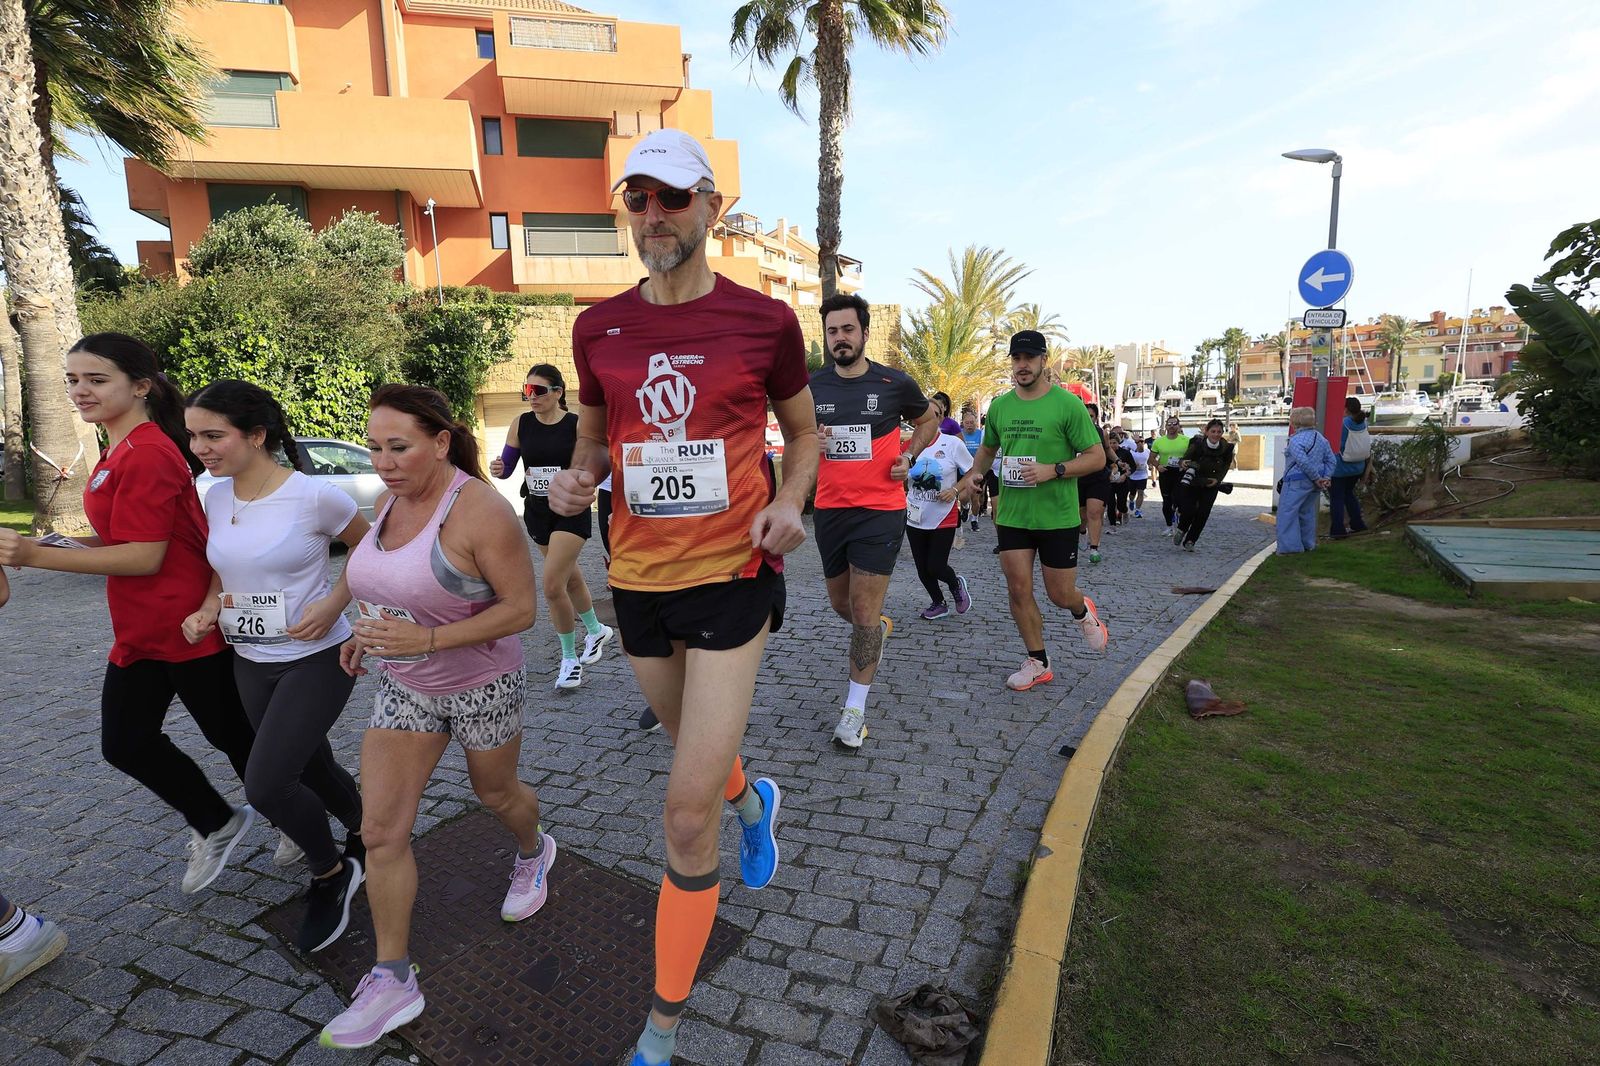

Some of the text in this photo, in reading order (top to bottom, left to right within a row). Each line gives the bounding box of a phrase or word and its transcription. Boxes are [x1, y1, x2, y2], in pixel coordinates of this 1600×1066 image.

[660, 443, 715, 457] The RUN
[835, 440, 857, 453] 253
[652, 465, 678, 474] OLIVER
[533, 480, 549, 489] 259
[650, 475, 696, 500] 205
[252, 596, 277, 604] RUN
[237, 616, 265, 635] 216
